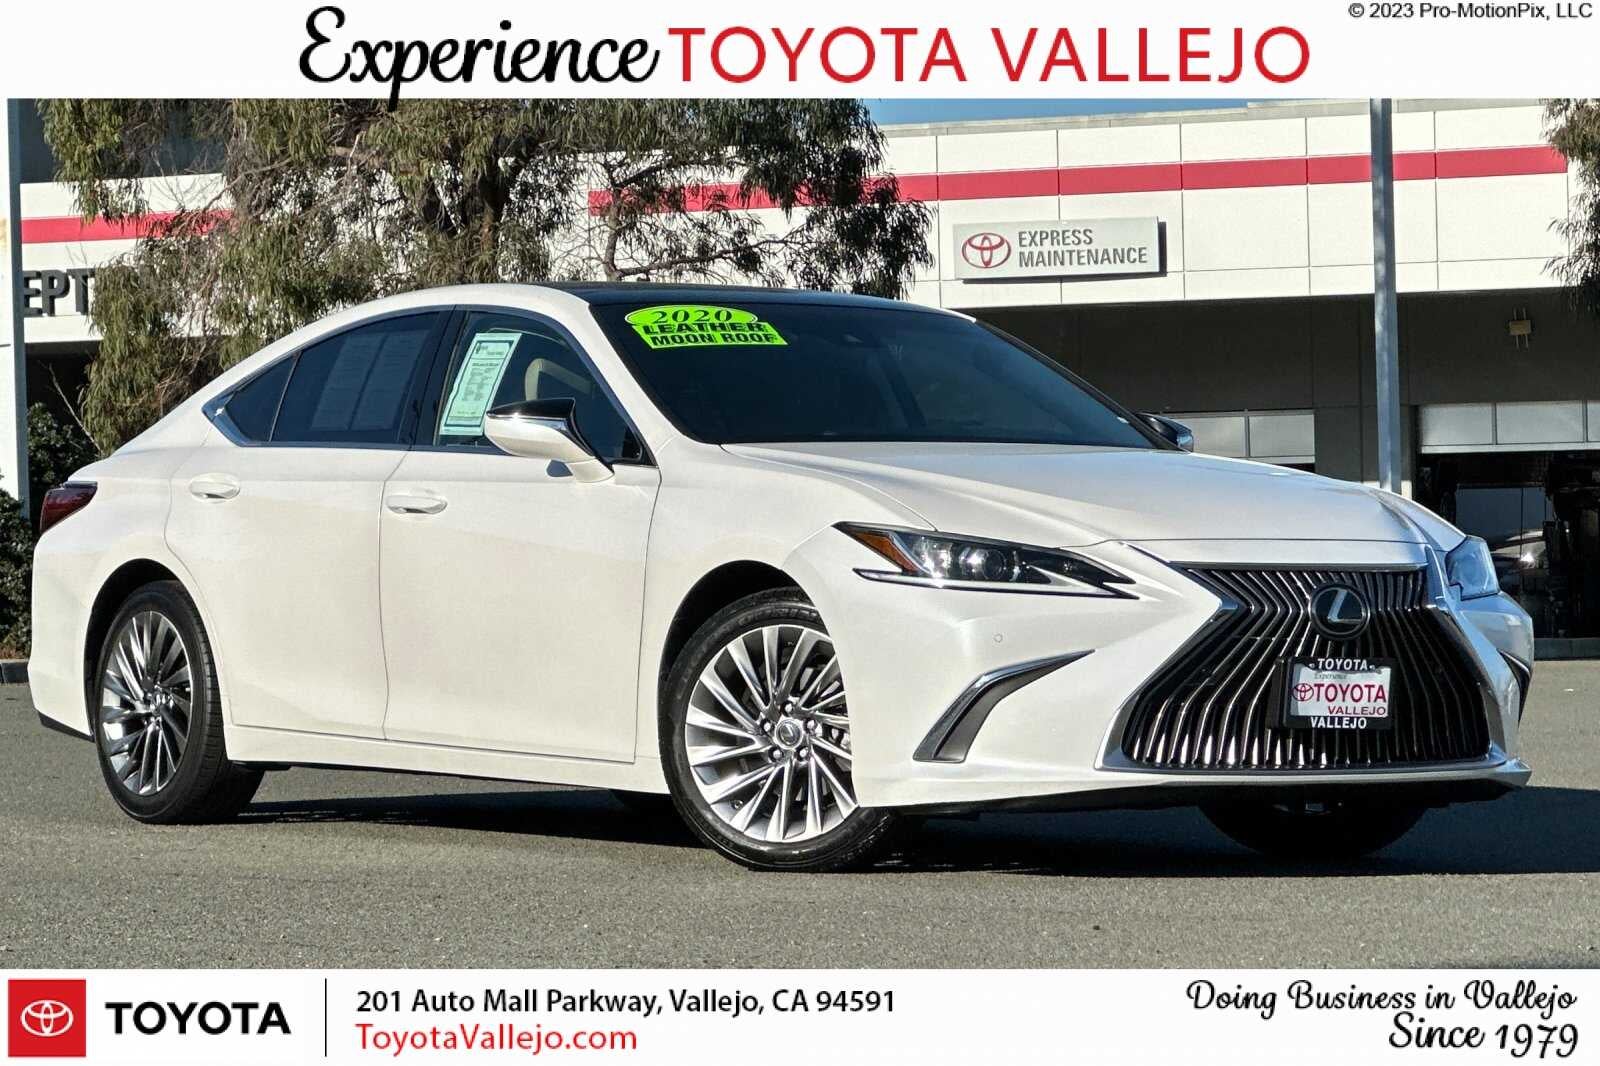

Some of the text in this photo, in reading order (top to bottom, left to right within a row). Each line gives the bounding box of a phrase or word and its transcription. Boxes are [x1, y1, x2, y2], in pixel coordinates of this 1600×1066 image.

[1018, 229, 1093, 248] EXPRESS
[1018, 247, 1148, 268] MAINTENANCE
[650, 309, 733, 324] 2020
[642, 322, 765, 336] LEATHER
[650, 333, 776, 346] MOON ROOF
[1317, 658, 1368, 671] TOYOTA
[1313, 683, 1387, 703] TOYOTA
[1327, 706, 1386, 715] VALLEJO
[1310, 716, 1367, 729] VALLEJO
